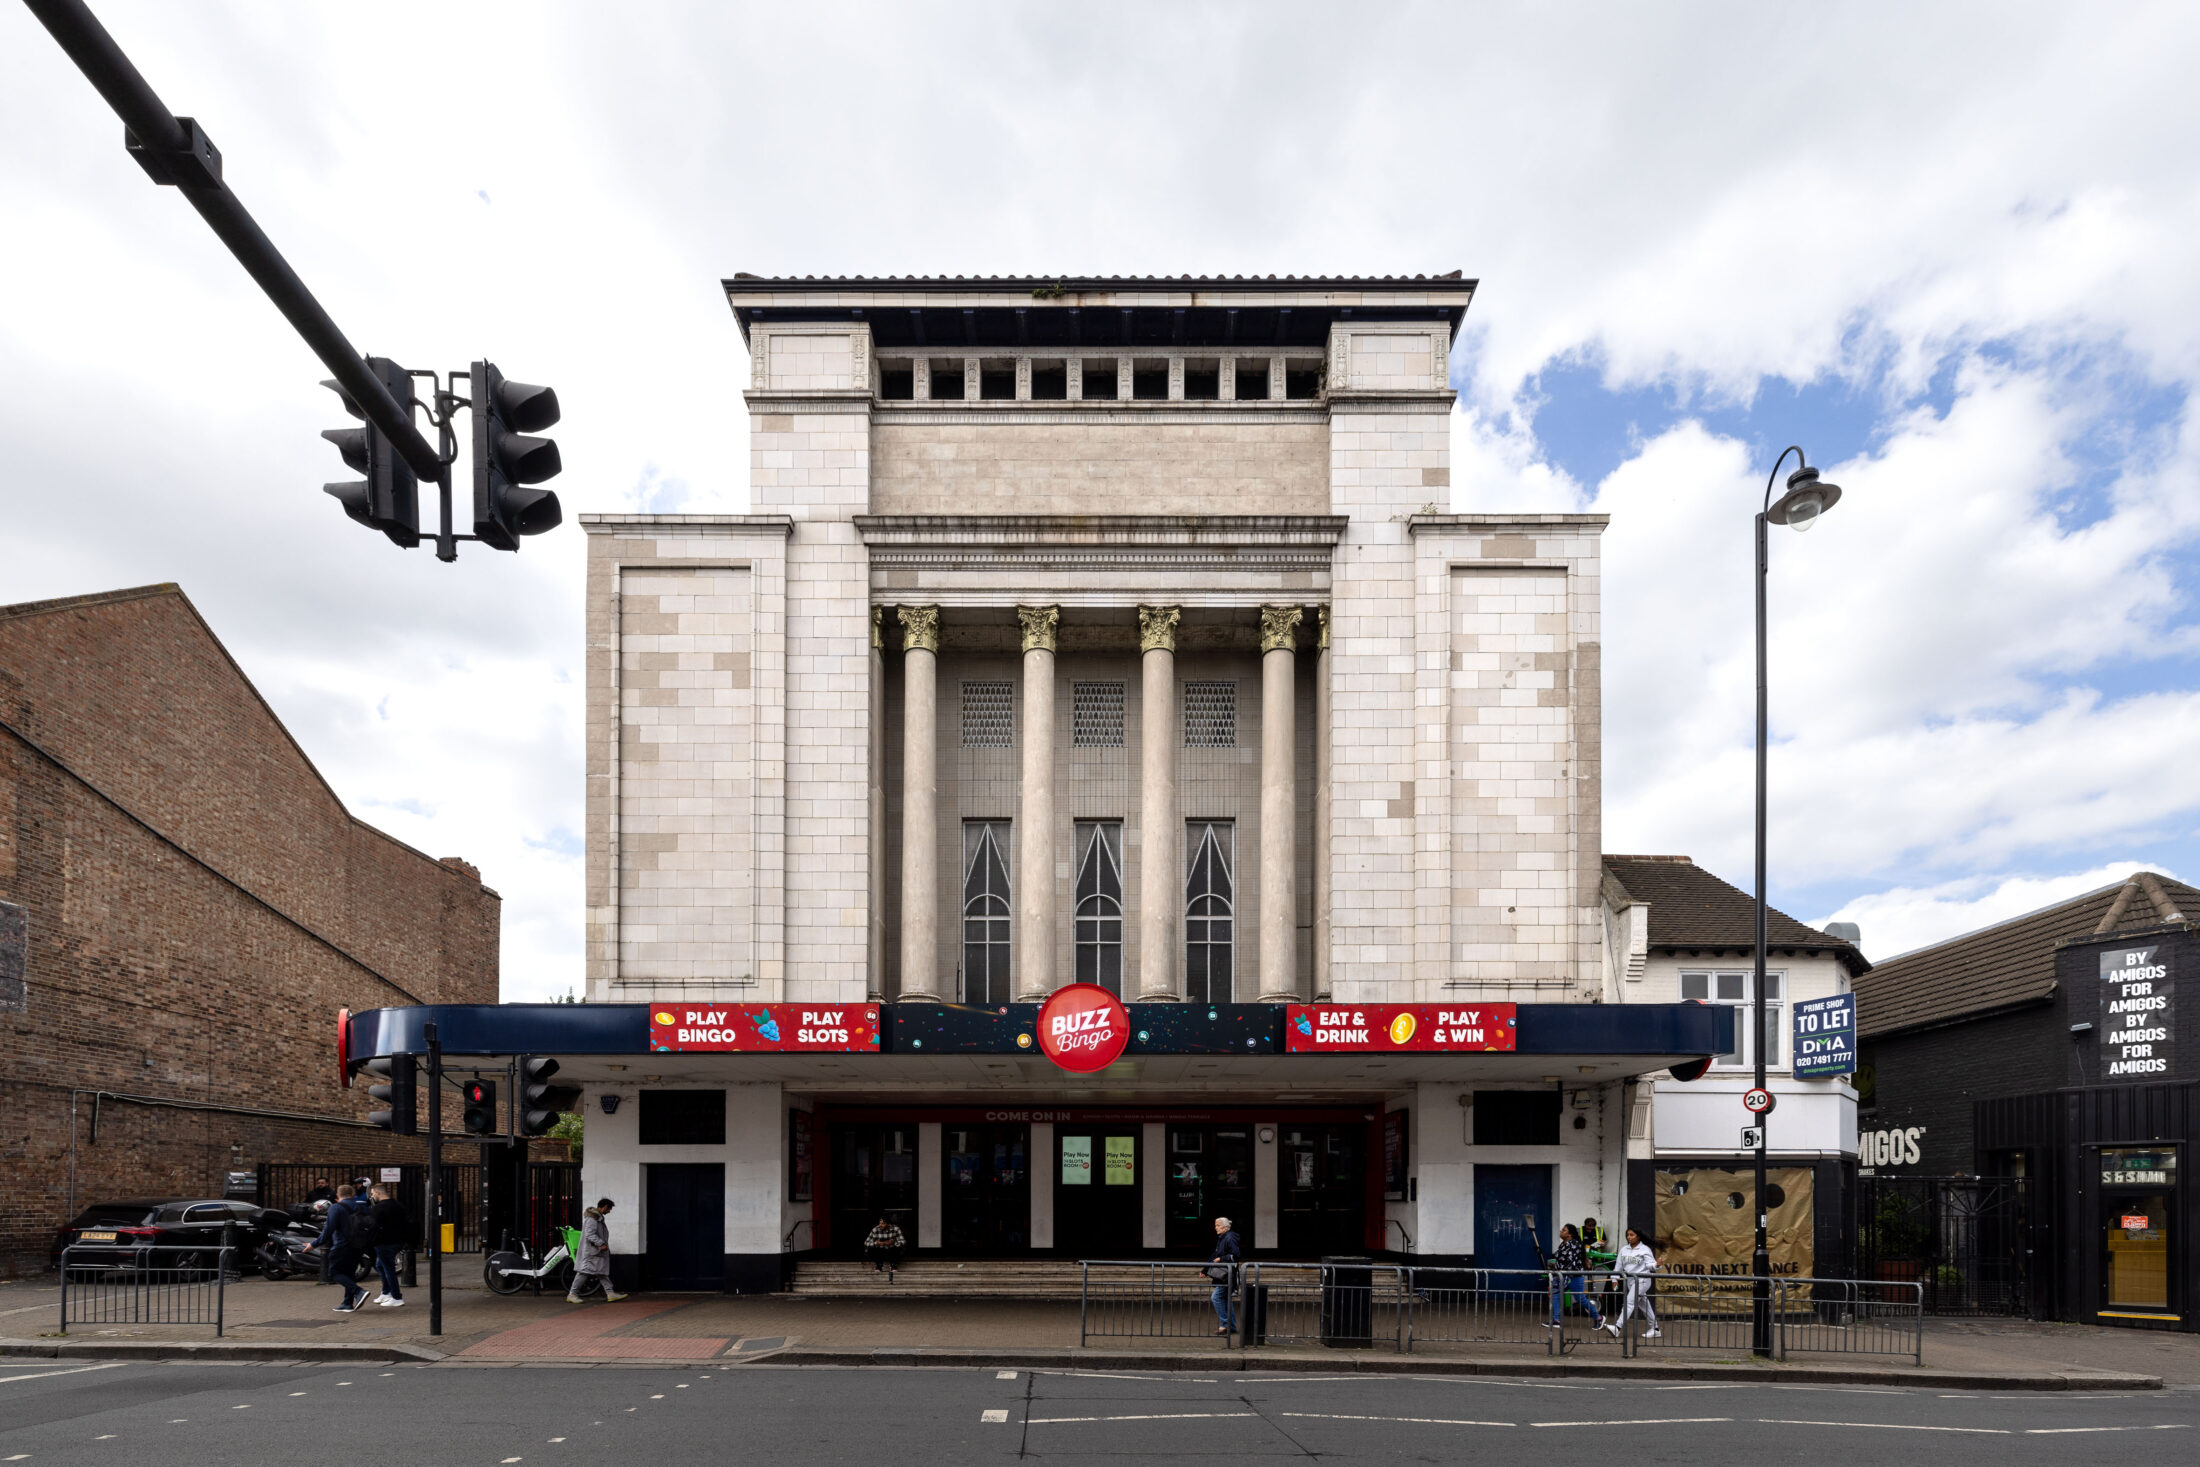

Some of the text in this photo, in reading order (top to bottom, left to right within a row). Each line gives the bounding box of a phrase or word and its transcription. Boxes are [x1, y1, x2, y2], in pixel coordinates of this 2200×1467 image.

[2126, 951, 2148, 966] BY
[2109, 965, 2166, 983] AMIGOS
[2122, 982, 2152, 997] FOR
[1803, 999, 1845, 1013] PRIME SHOP
[2109, 996, 2166, 1014] AMIGOS
[686, 1012, 727, 1025] PLAY
[802, 1012, 843, 1025] PLAY
[1051, 1007, 1112, 1036] BUZZ
[1319, 1012, 1365, 1025] EAT &
[1438, 1011, 1480, 1025] PLAY
[1797, 1008, 1851, 1033] TO LET
[2126, 1013, 2148, 1028] BY
[678, 1029, 736, 1043] BINGO
[797, 1029, 848, 1043] SLOTS
[1056, 1028, 1116, 1053] Bingo
[1315, 1029, 1369, 1043] DRINK
[1433, 1029, 1484, 1043] & WIN
[2109, 1027, 2166, 1044] AMIGOS
[1802, 1036, 1845, 1054] DMA
[2122, 1044, 2152, 1058] FOR
[1796, 1051, 1852, 1067] 020 7491 7777
[1803, 1065, 1846, 1074] dmaproperty.com
[2109, 1058, 2166, 1075] AMIGOS
[1747, 1094, 1766, 1106] 20
[985, 1112, 1071, 1121] COME ON IN
[1664, 1261, 1798, 1276] YOUR NEXT ANCE
